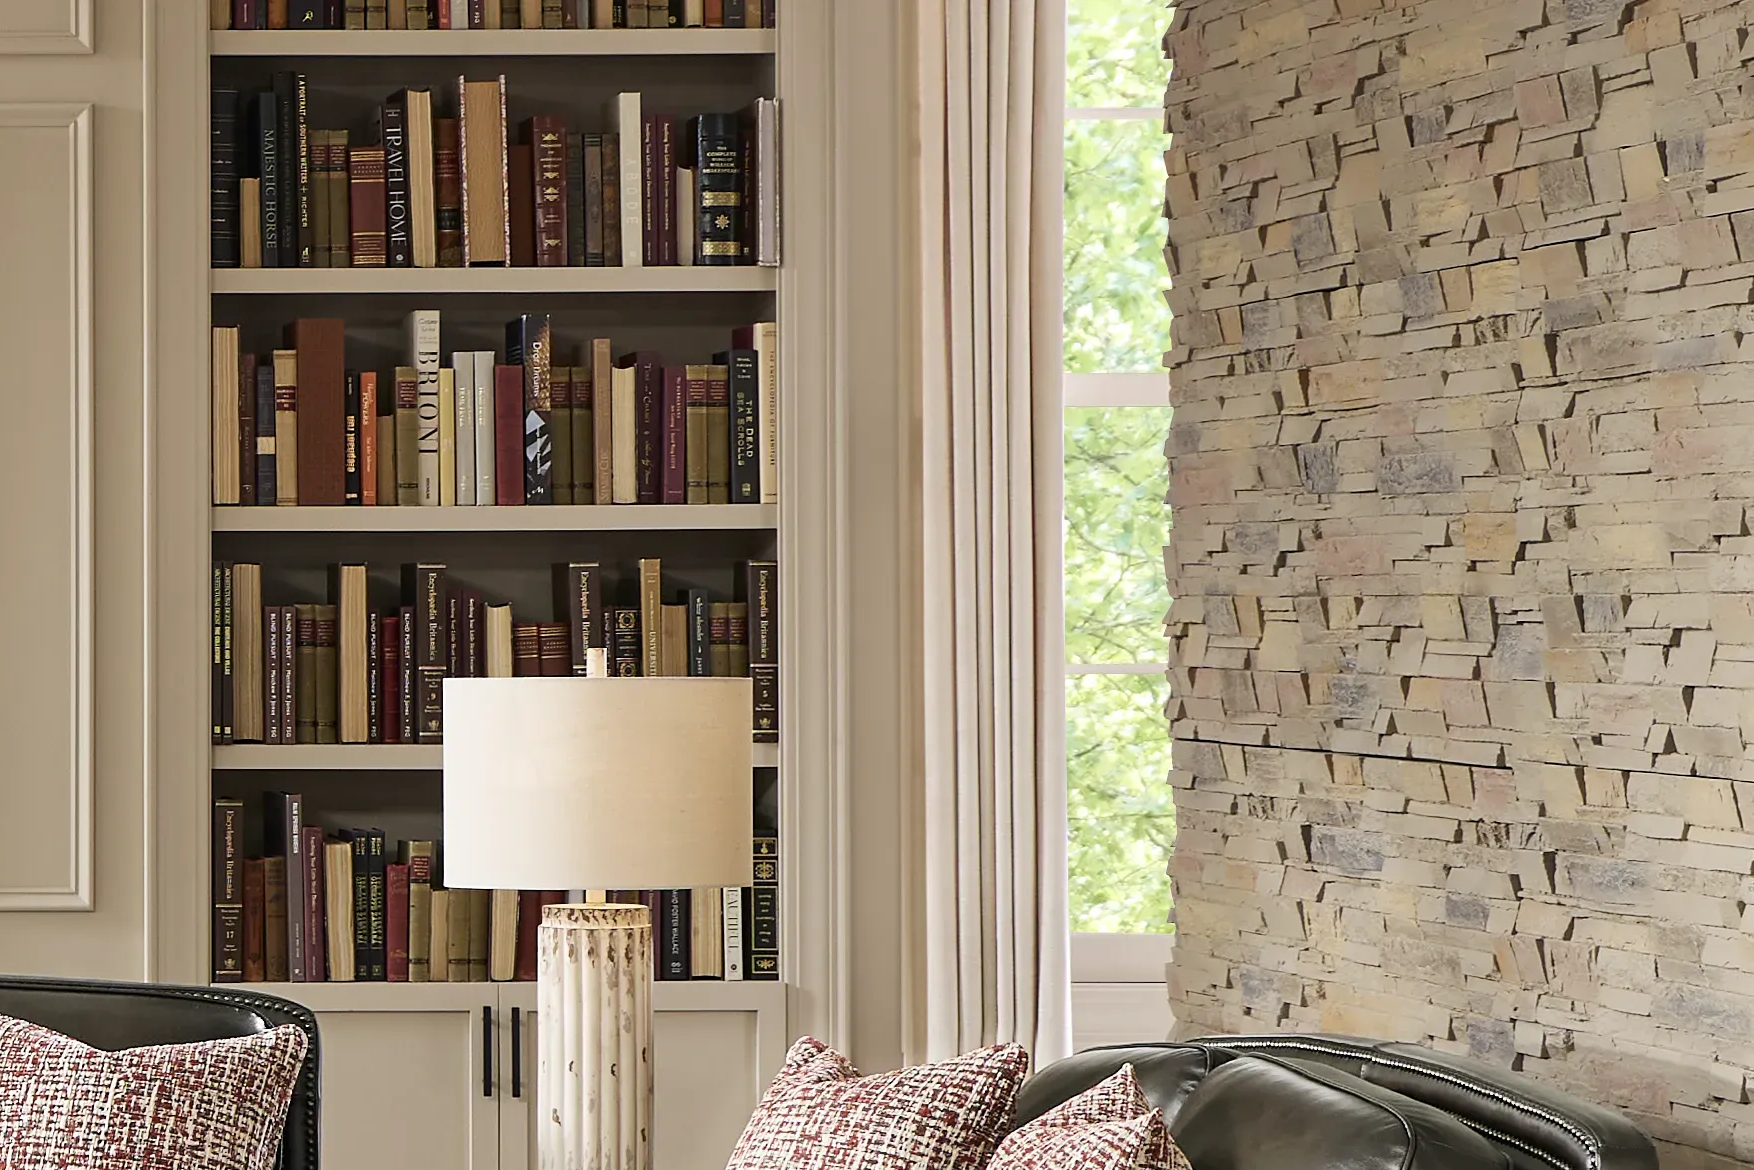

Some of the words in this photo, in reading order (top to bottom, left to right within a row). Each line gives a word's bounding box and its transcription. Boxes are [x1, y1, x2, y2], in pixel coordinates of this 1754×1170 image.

[264, 130, 275, 195] MAJESTIC
[385, 124, 405, 186] TRAVEL
[625, 158, 639, 225] ABODE
[265, 202, 277, 248] HORSE
[388, 191, 407, 247] HOME
[418, 351, 439, 453] BRIONI
[533, 367, 543, 398] Dreams
[736, 392, 745, 412] SEA
[745, 400, 753, 422] THE
[737, 419, 745, 465] SCROLLS
[745, 429, 754, 457] DEAD
[649, 631, 657, 676] UNIVERSITI
[226, 931, 234, 939] 17
[671, 905, 679, 926] FOSTER
[727, 889, 739, 953] EAUTIFUL
[671, 928, 679, 955] WALLACE
